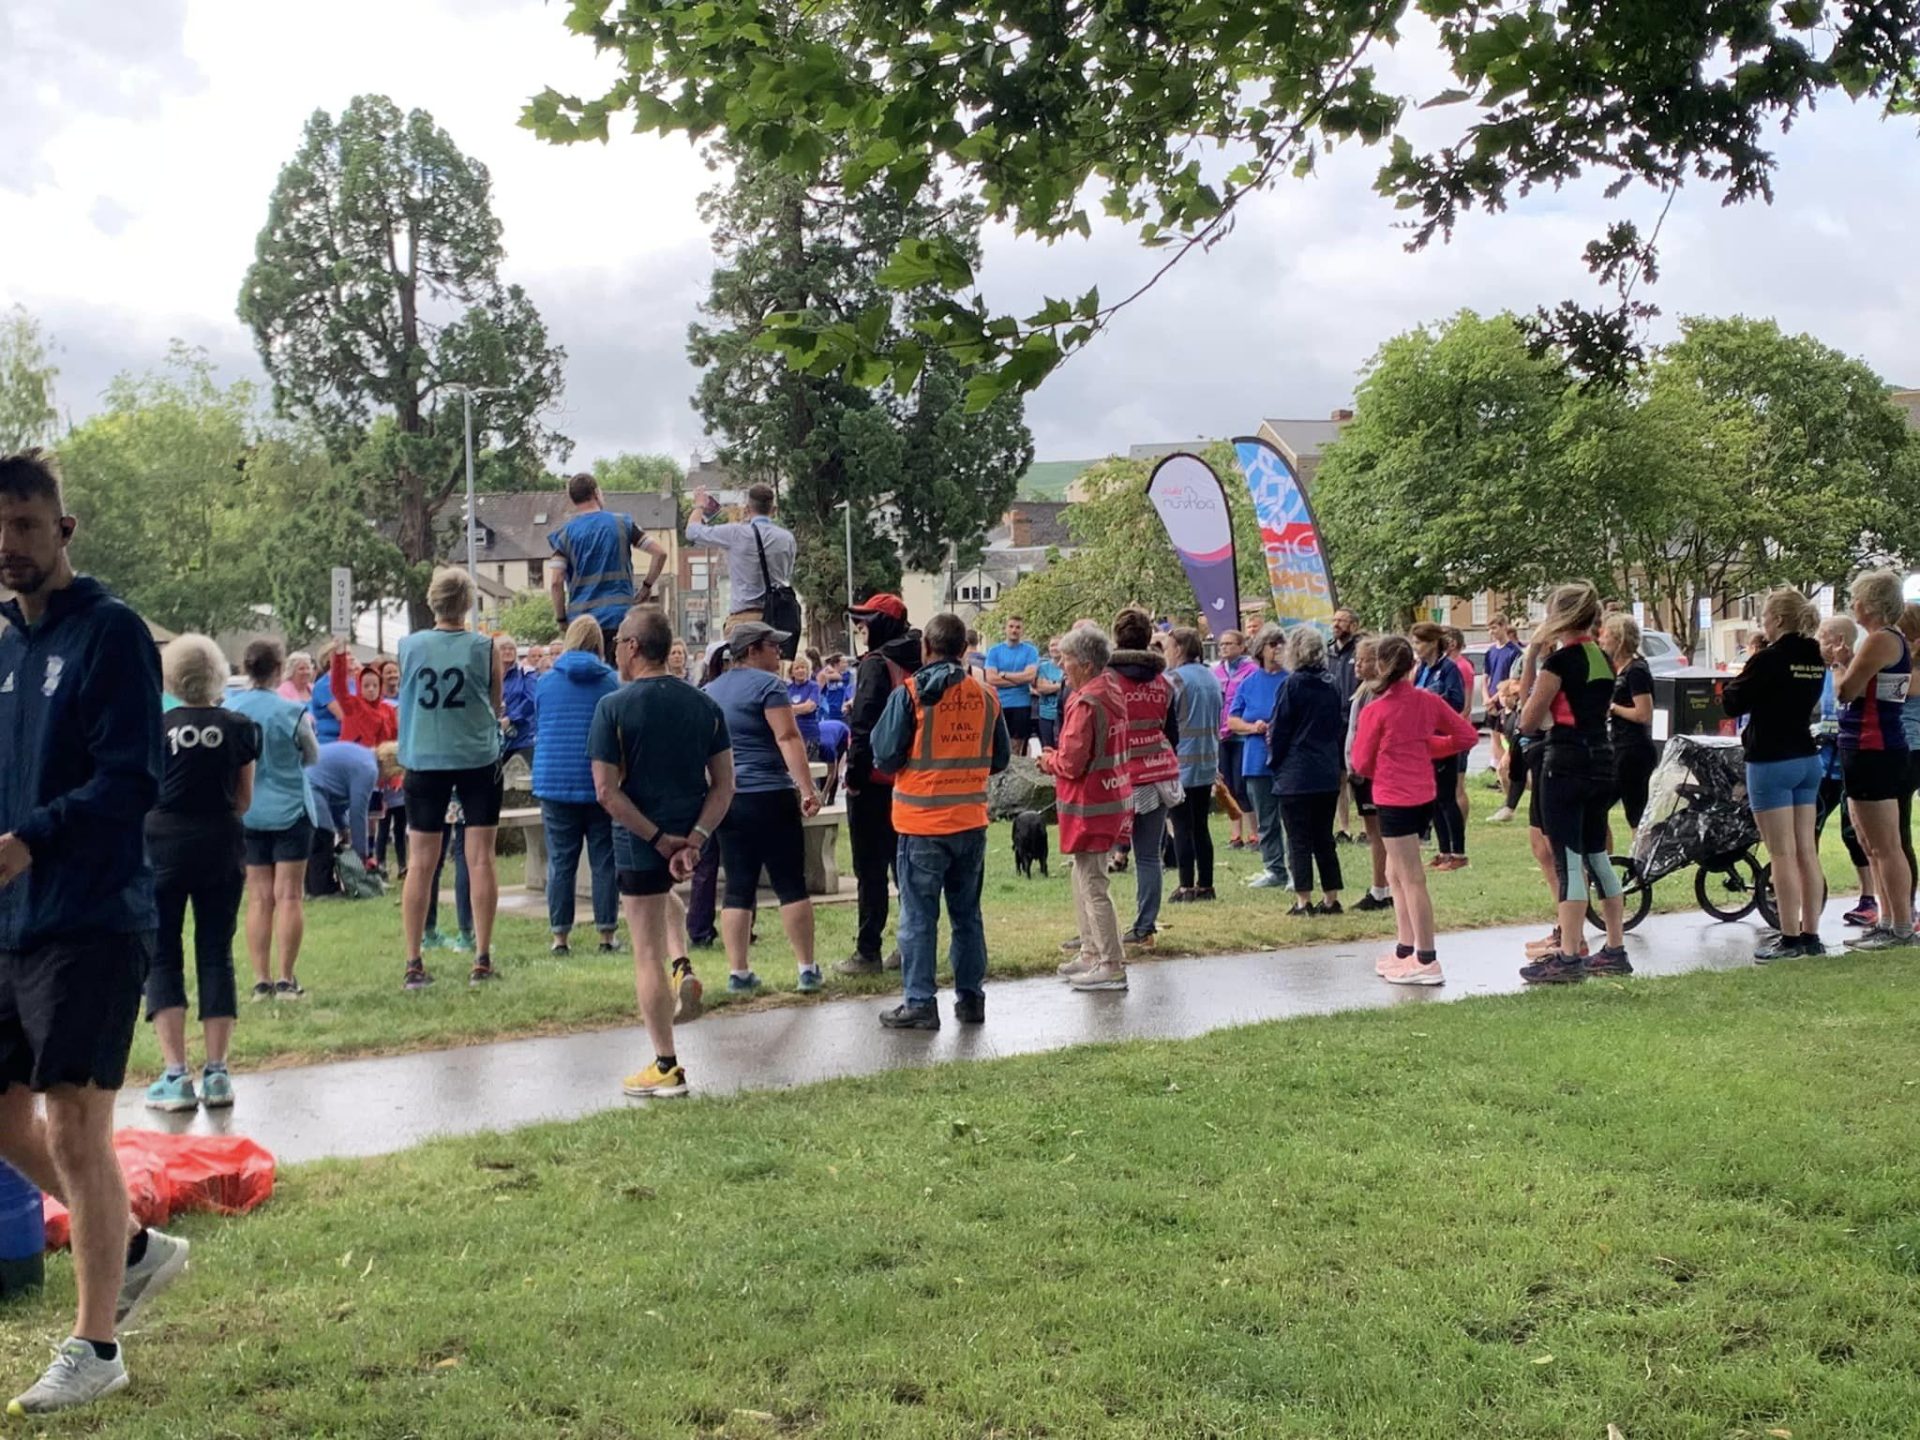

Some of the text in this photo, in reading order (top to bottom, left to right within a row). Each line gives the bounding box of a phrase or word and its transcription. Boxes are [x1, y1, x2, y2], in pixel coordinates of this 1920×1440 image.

[337, 579, 345, 625] QUIET
[418, 667, 466, 709] 32
[1124, 690, 1167, 703] parkrun
[167, 725, 223, 756] 100
[950, 722, 974, 731] TAIL
